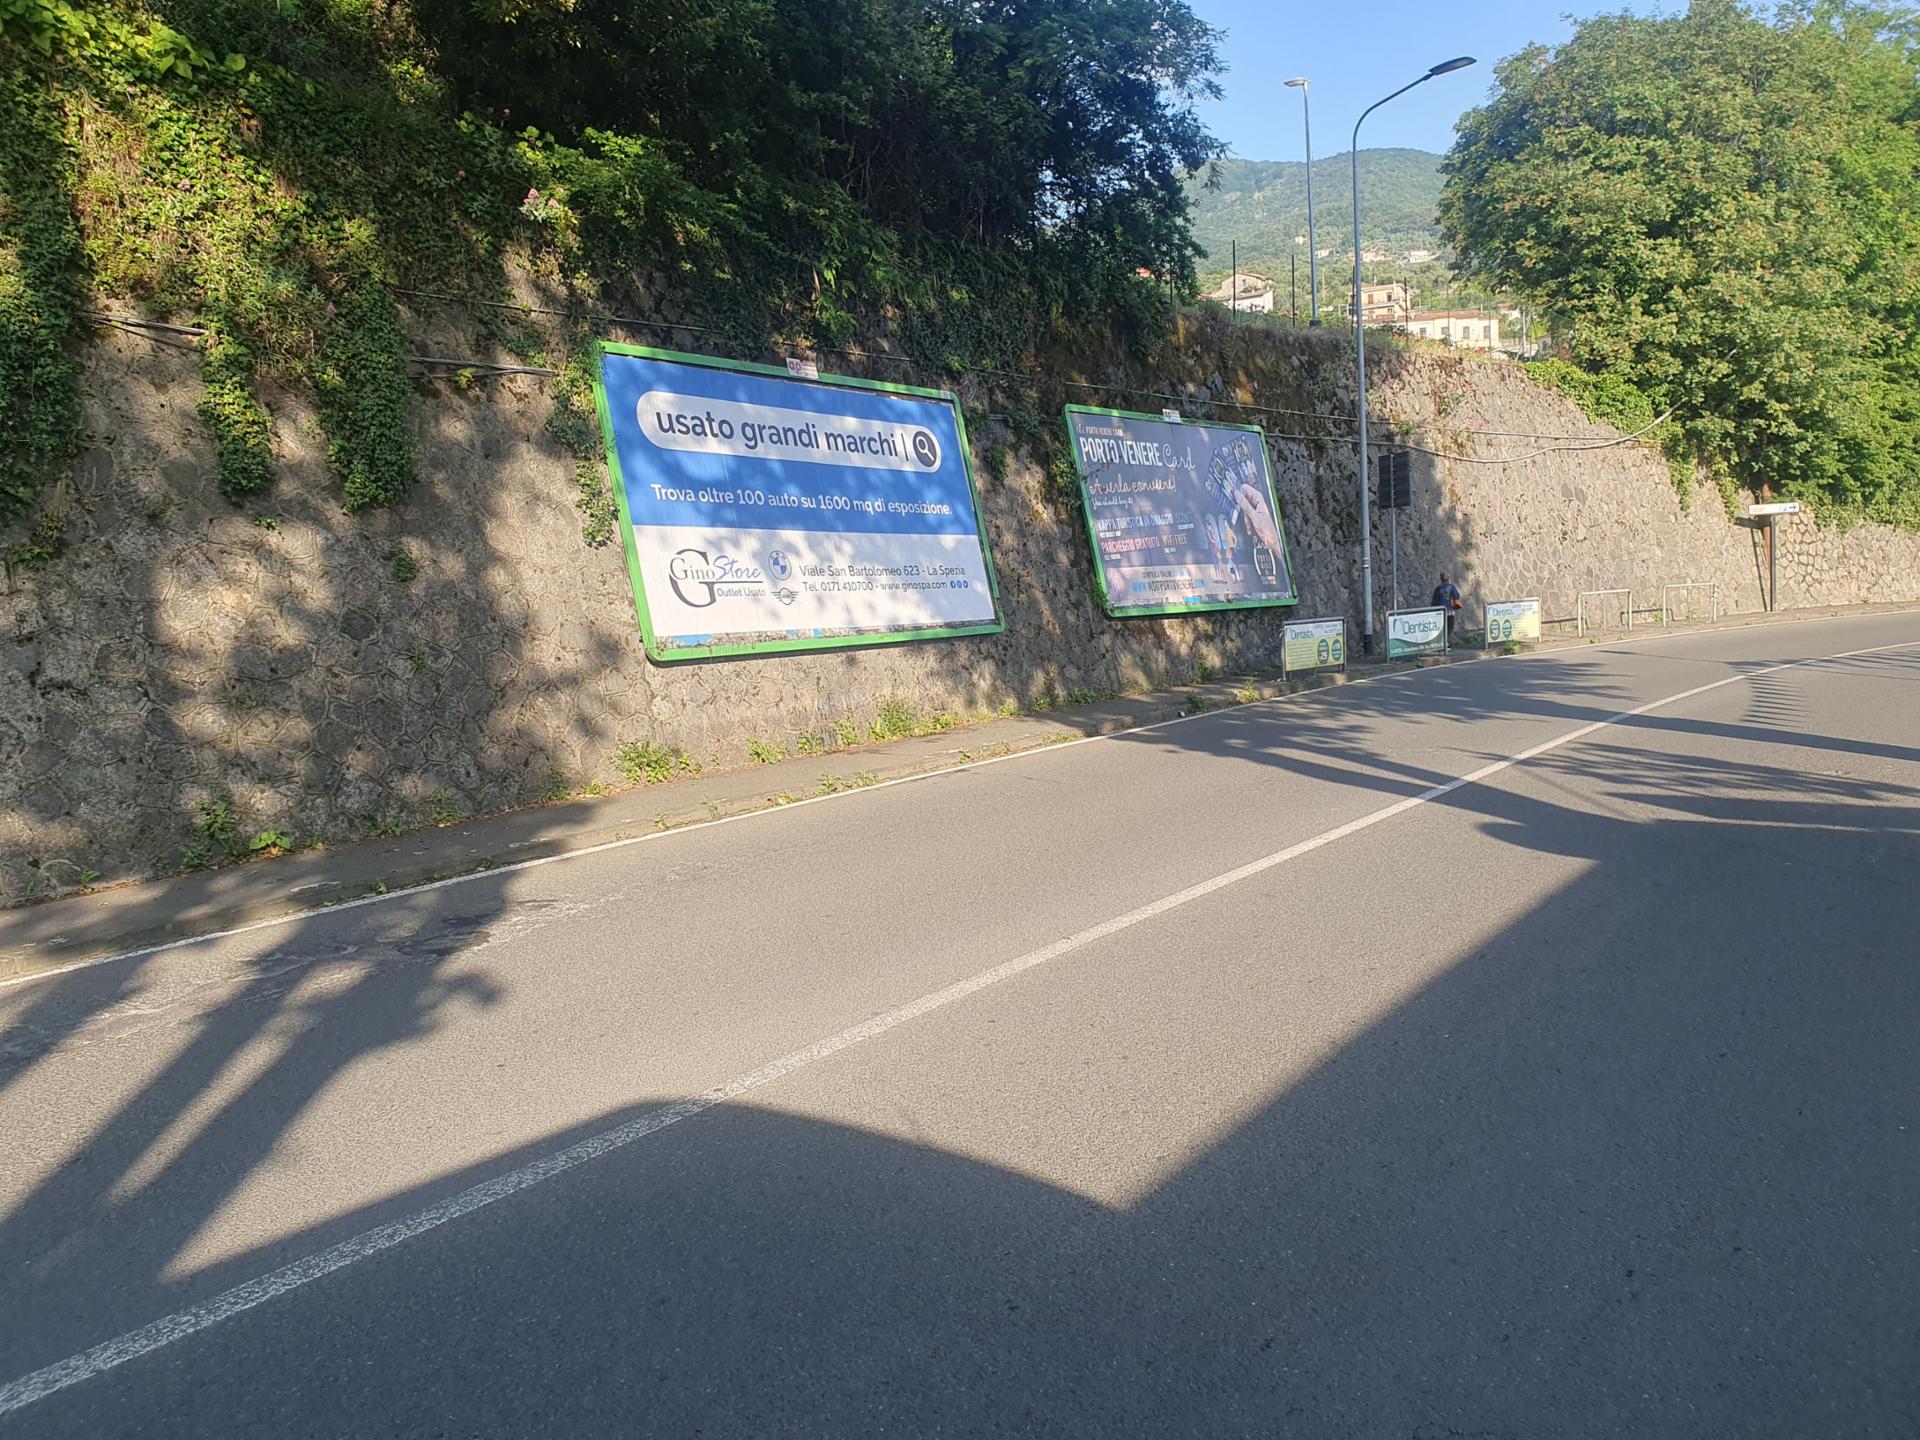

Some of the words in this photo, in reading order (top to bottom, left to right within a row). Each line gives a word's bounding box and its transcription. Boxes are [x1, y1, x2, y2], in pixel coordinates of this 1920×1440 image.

[656, 411, 734, 439] usato
[741, 421, 820, 449] grandi
[825, 431, 898, 456] marchi
[1080, 437, 1119, 464] PORTO
[1119, 440, 1163, 466] VENERE
[1163, 443, 1196, 470] Card
[650, 484, 695, 501] Trova
[699, 487, 734, 503] oltre
[737, 489, 764, 505] 100
[768, 493, 798, 507] auto
[801, 496, 816, 508] su
[818, 494, 850, 510] 1600
[853, 501, 873, 515] mq
[875, 498, 886, 512] di
[888, 501, 952, 516] esposizione.
[670, 557, 715, 580] Gino
[713, 555, 760, 580] Store
[799, 565, 825, 577] Viale
[827, 565, 846, 577] San
[848, 565, 901, 577] Bartolomeo
[903, 565, 920, 576] 623
[927, 565, 938, 576] La
[939, 565, 966, 578] Spezia
[717, 588, 742, 597] Outlet
[744, 588, 766, 597] Usato
[880, 580, 947, 592] www.ginospa.com
[1403, 620, 1437, 635] Dentista
